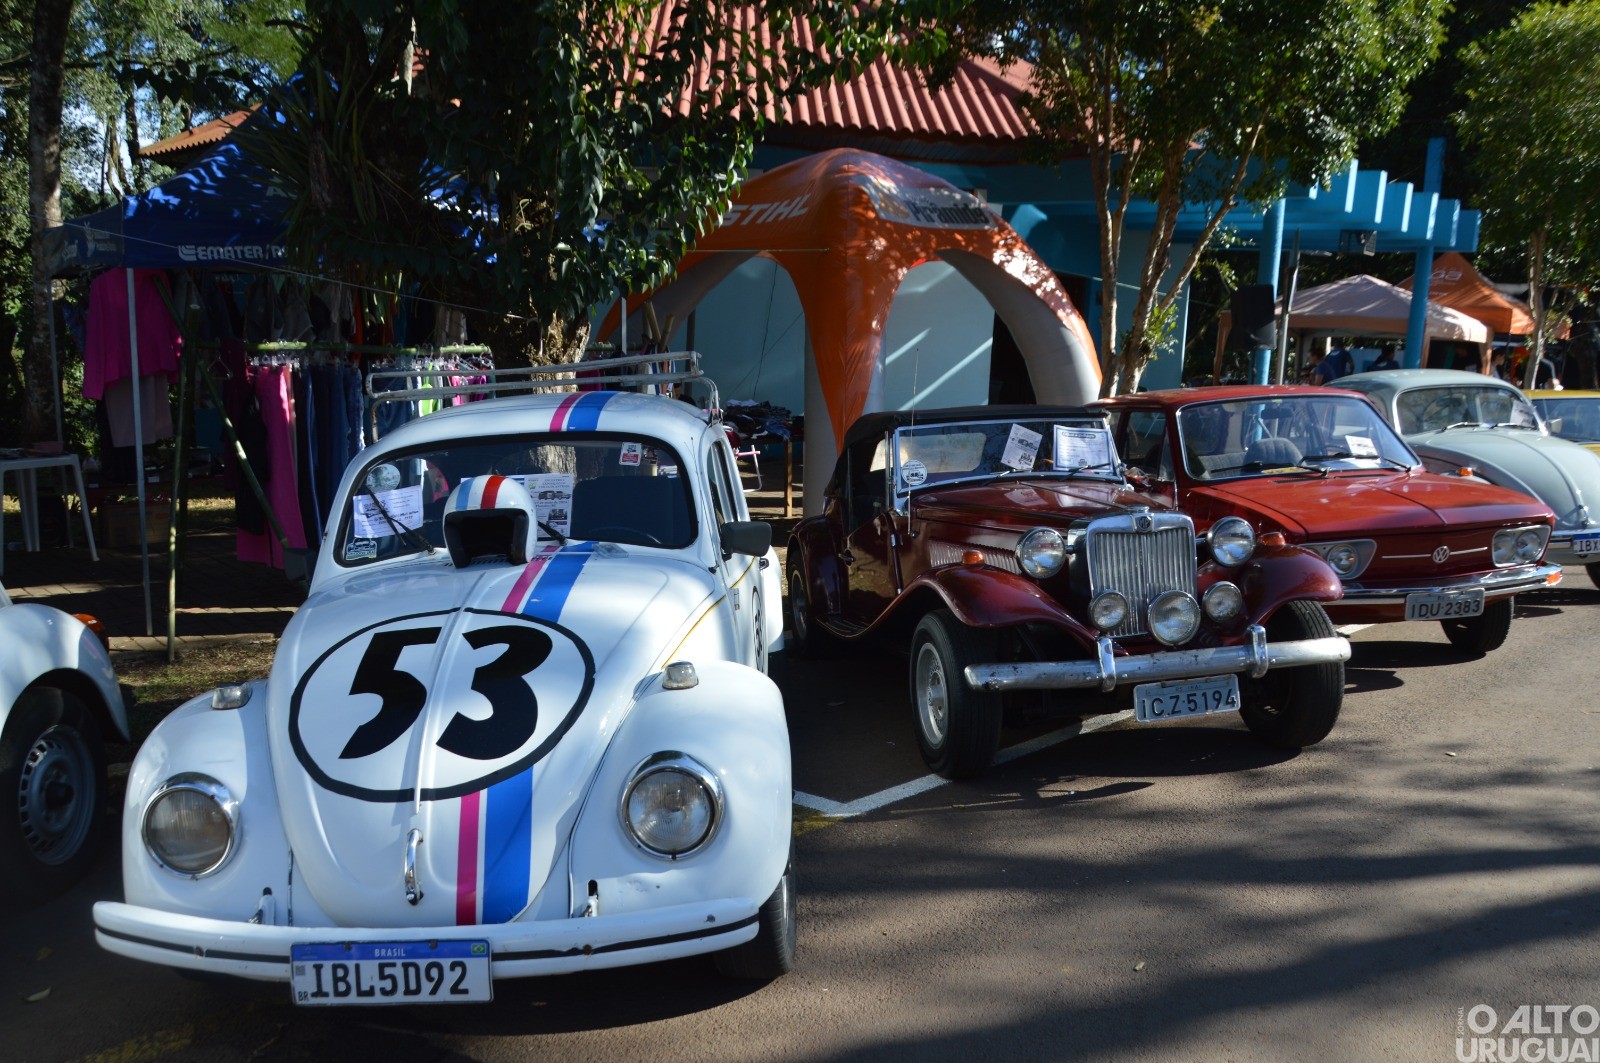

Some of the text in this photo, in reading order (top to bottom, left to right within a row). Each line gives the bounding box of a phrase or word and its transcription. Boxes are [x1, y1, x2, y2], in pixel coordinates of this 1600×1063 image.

[714, 193, 812, 226] STIHL
[338, 625, 553, 760] 53
[374, 948, 406, 957] BRASIL
[310, 960, 469, 998] IBL5D92
